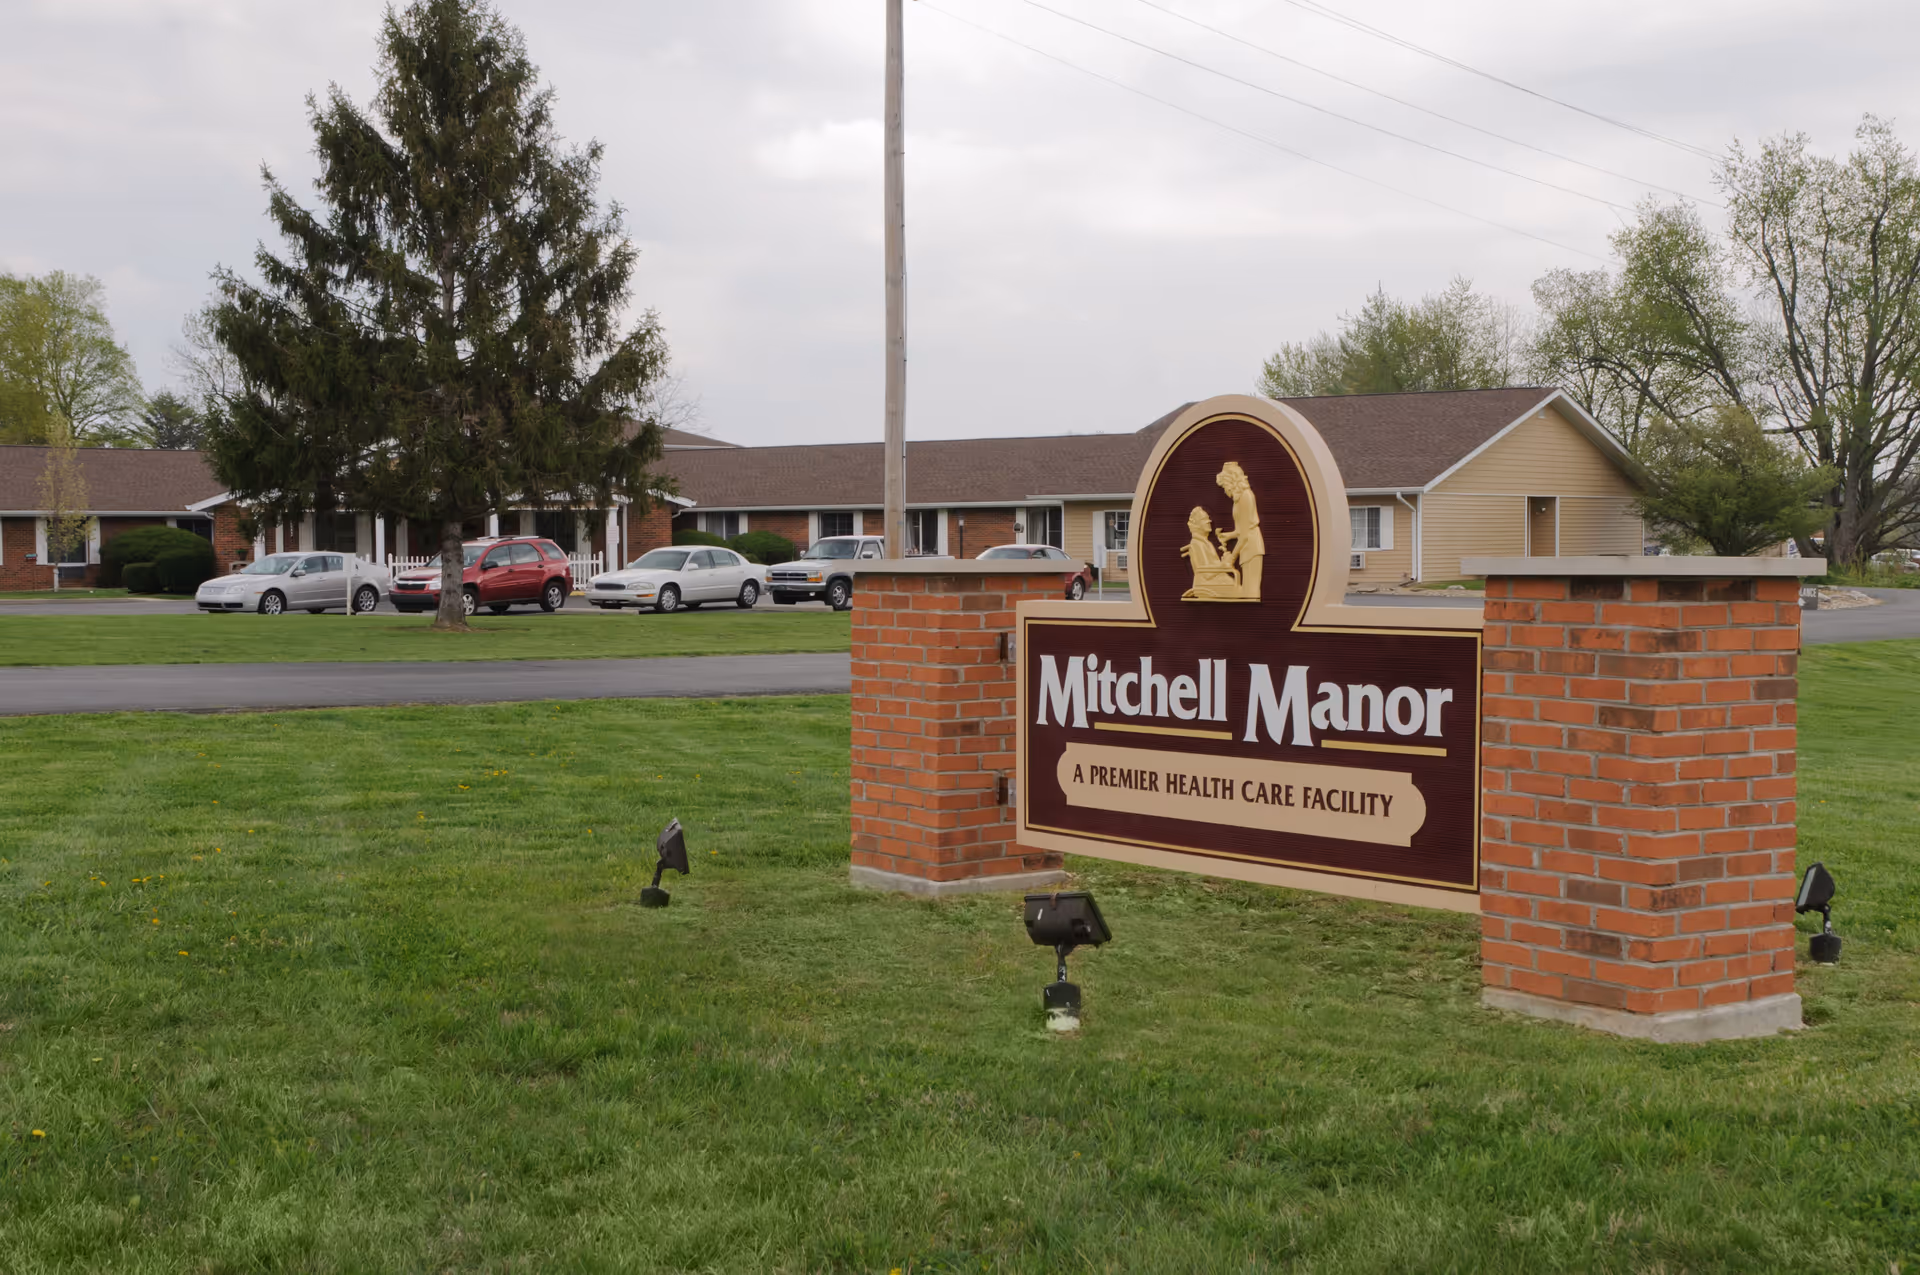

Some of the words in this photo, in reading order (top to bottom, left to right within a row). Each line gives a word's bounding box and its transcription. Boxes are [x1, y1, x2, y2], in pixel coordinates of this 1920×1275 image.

[1799, 587, 1817, 598] LANCE
[1036, 653, 1228, 729] Mitchell
[1243, 663, 1453, 747] Manor
[1073, 763, 1085, 784] A
[1090, 764, 1160, 793] PREMIER
[1166, 772, 1235, 801] HEALTH
[1242, 780, 1296, 808] CARE
[1303, 786, 1394, 818] FACILITY
